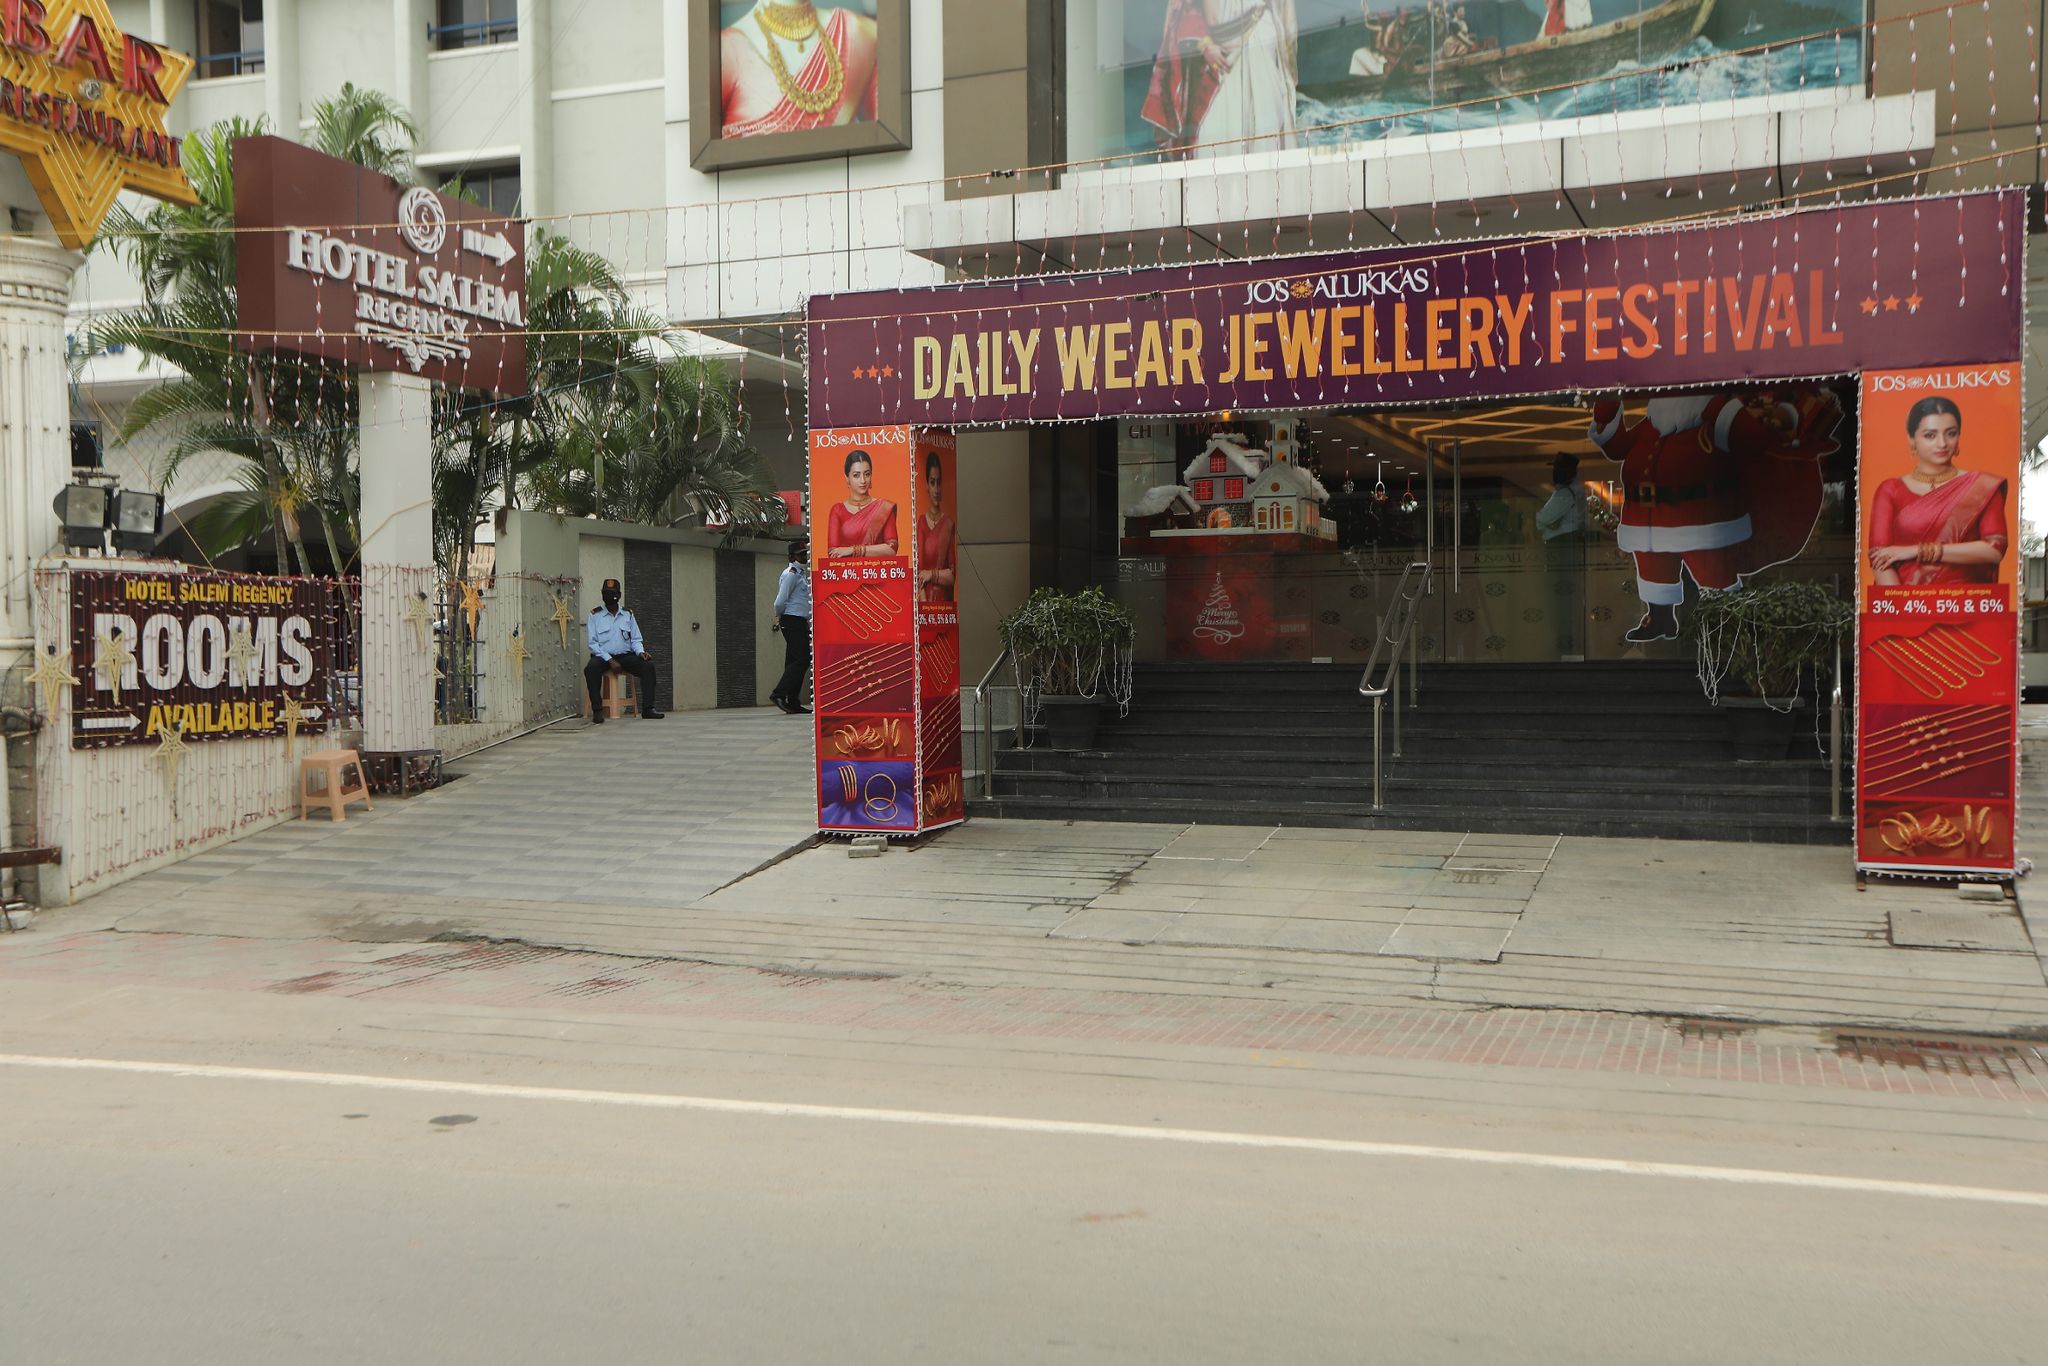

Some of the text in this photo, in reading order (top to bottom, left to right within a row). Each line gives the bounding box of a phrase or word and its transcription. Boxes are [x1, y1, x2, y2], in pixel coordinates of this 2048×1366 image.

[3, 0, 170, 106] BAR
[0, 75, 182, 168] RESTAURANT
[285, 226, 525, 328] HOTEL SALEM
[1244, 268, 1429, 306] JOS ALUKKAS
[355, 292, 470, 343] REGENCY
[913, 269, 1845, 400] DAILY WEAR JEWELLERY FESTIVAL
[1871, 370, 2011, 392] JOS ALUKKAS
[815, 431, 906, 448] JOS ALUKKAS
[125, 580, 293, 604] HOTEL SALEM REGENCY
[822, 567, 906, 581] 3%, 4%, 5% & 6%
[1872, 598, 2004, 615] 3%, 4%, 5% & 6%
[94, 613, 313, 691] ROOMS
[146, 701, 275, 736] AVAILABLE
